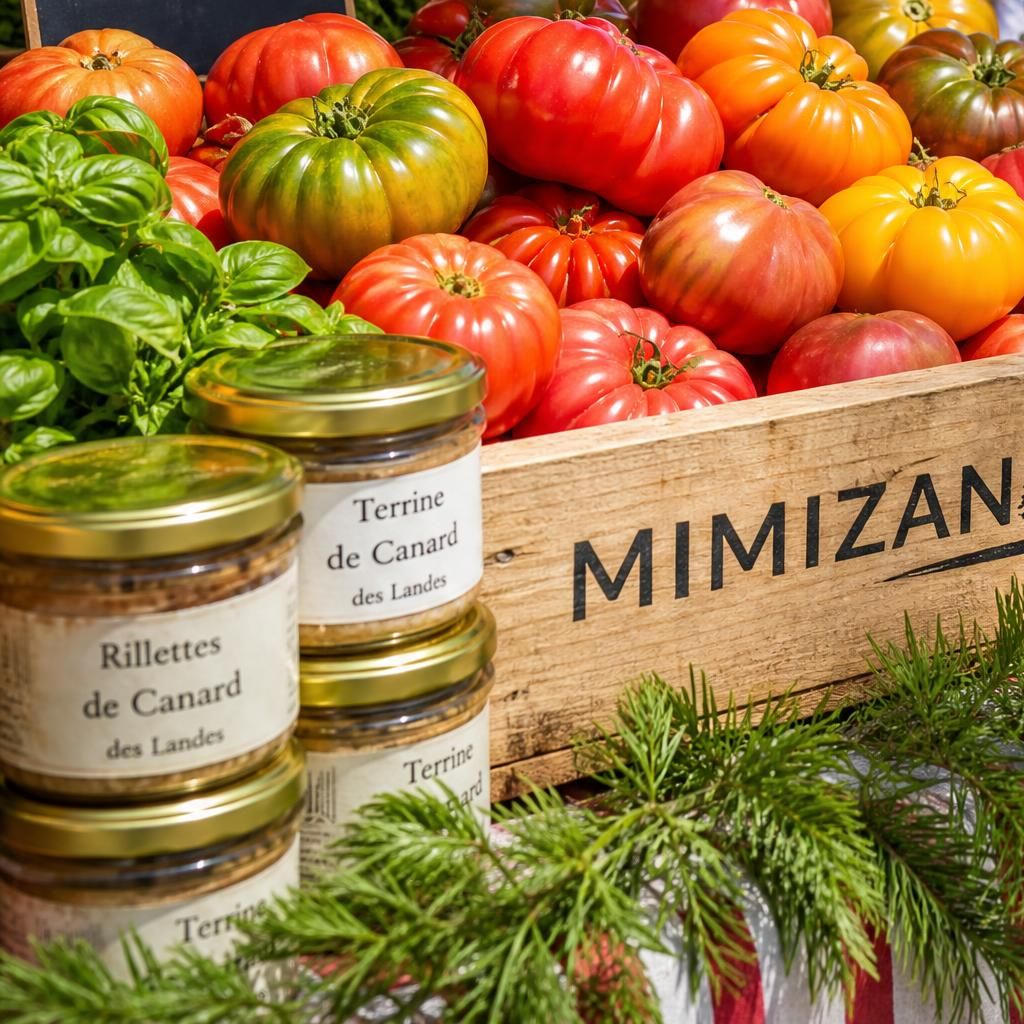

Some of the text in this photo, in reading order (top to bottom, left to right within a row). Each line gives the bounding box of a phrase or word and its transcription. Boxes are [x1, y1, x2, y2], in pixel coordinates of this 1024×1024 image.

[353, 491, 444, 522] Terrine
[327, 521, 458, 570] de Canard
[573, 456, 1012, 622] MIMIZAN
[352, 574, 447, 607] des Landes
[100, 635, 221, 670] Rillettes
[82, 670, 242, 719] de Canard
[106, 728, 224, 760] des Landes
[403, 744, 473, 784] Terrine
